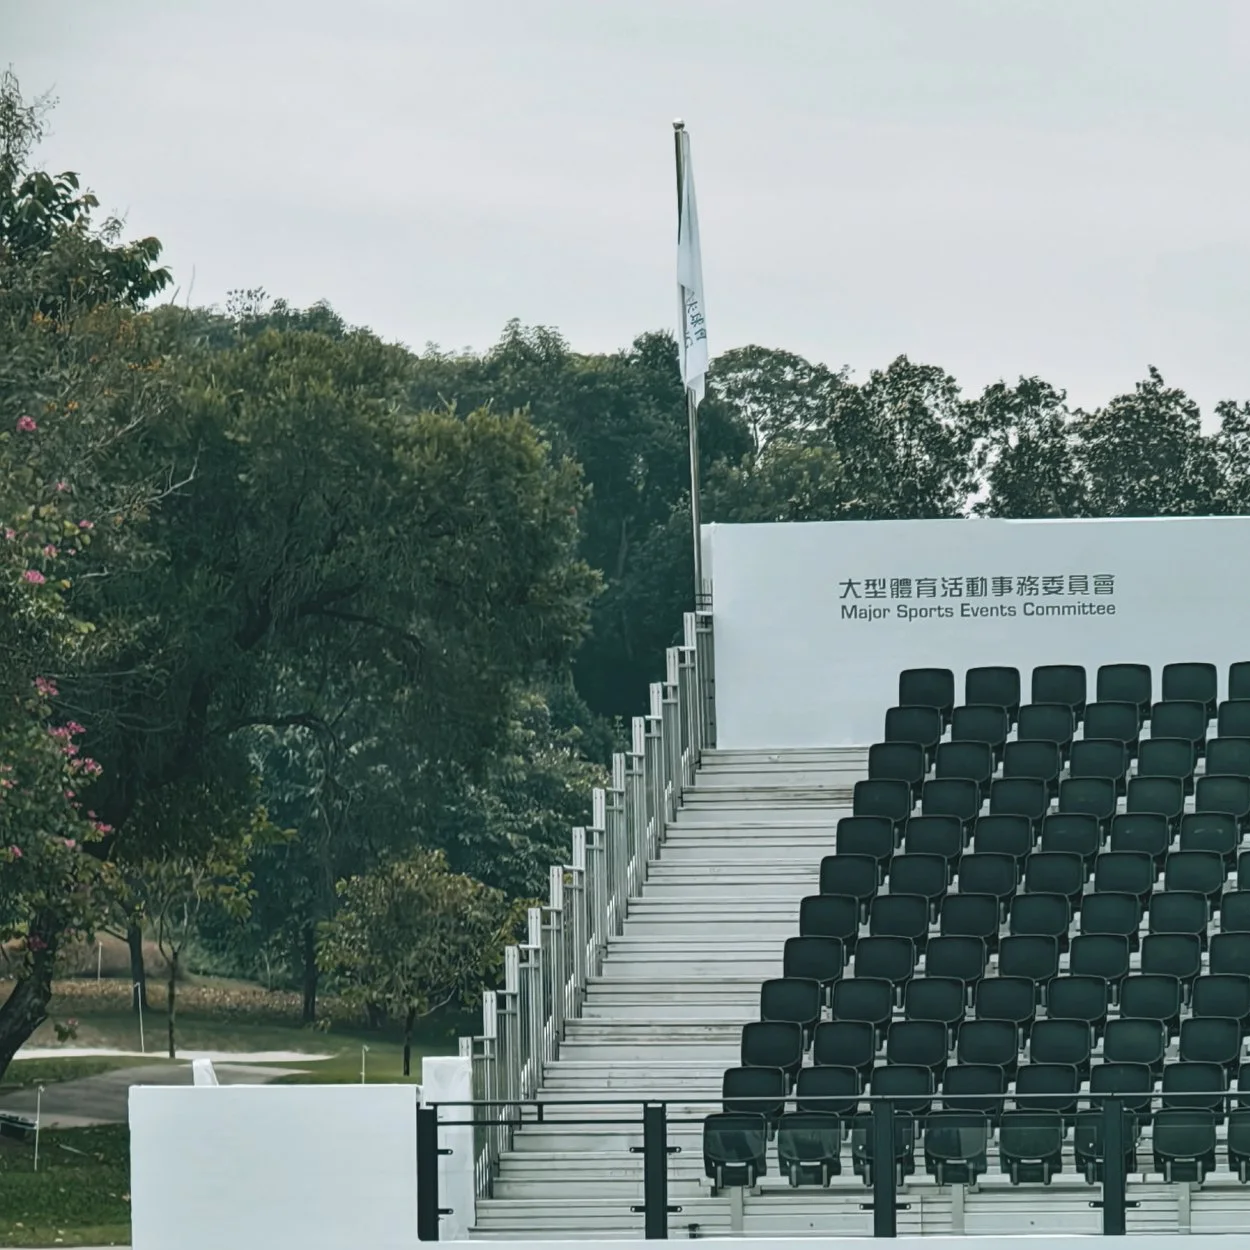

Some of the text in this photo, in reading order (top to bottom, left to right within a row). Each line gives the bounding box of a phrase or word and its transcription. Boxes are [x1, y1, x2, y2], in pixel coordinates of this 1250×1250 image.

[838, 574, 1116, 599] 大型體育活動事務委員會
[841, 601, 1116, 622] Major Sports Events Committee
